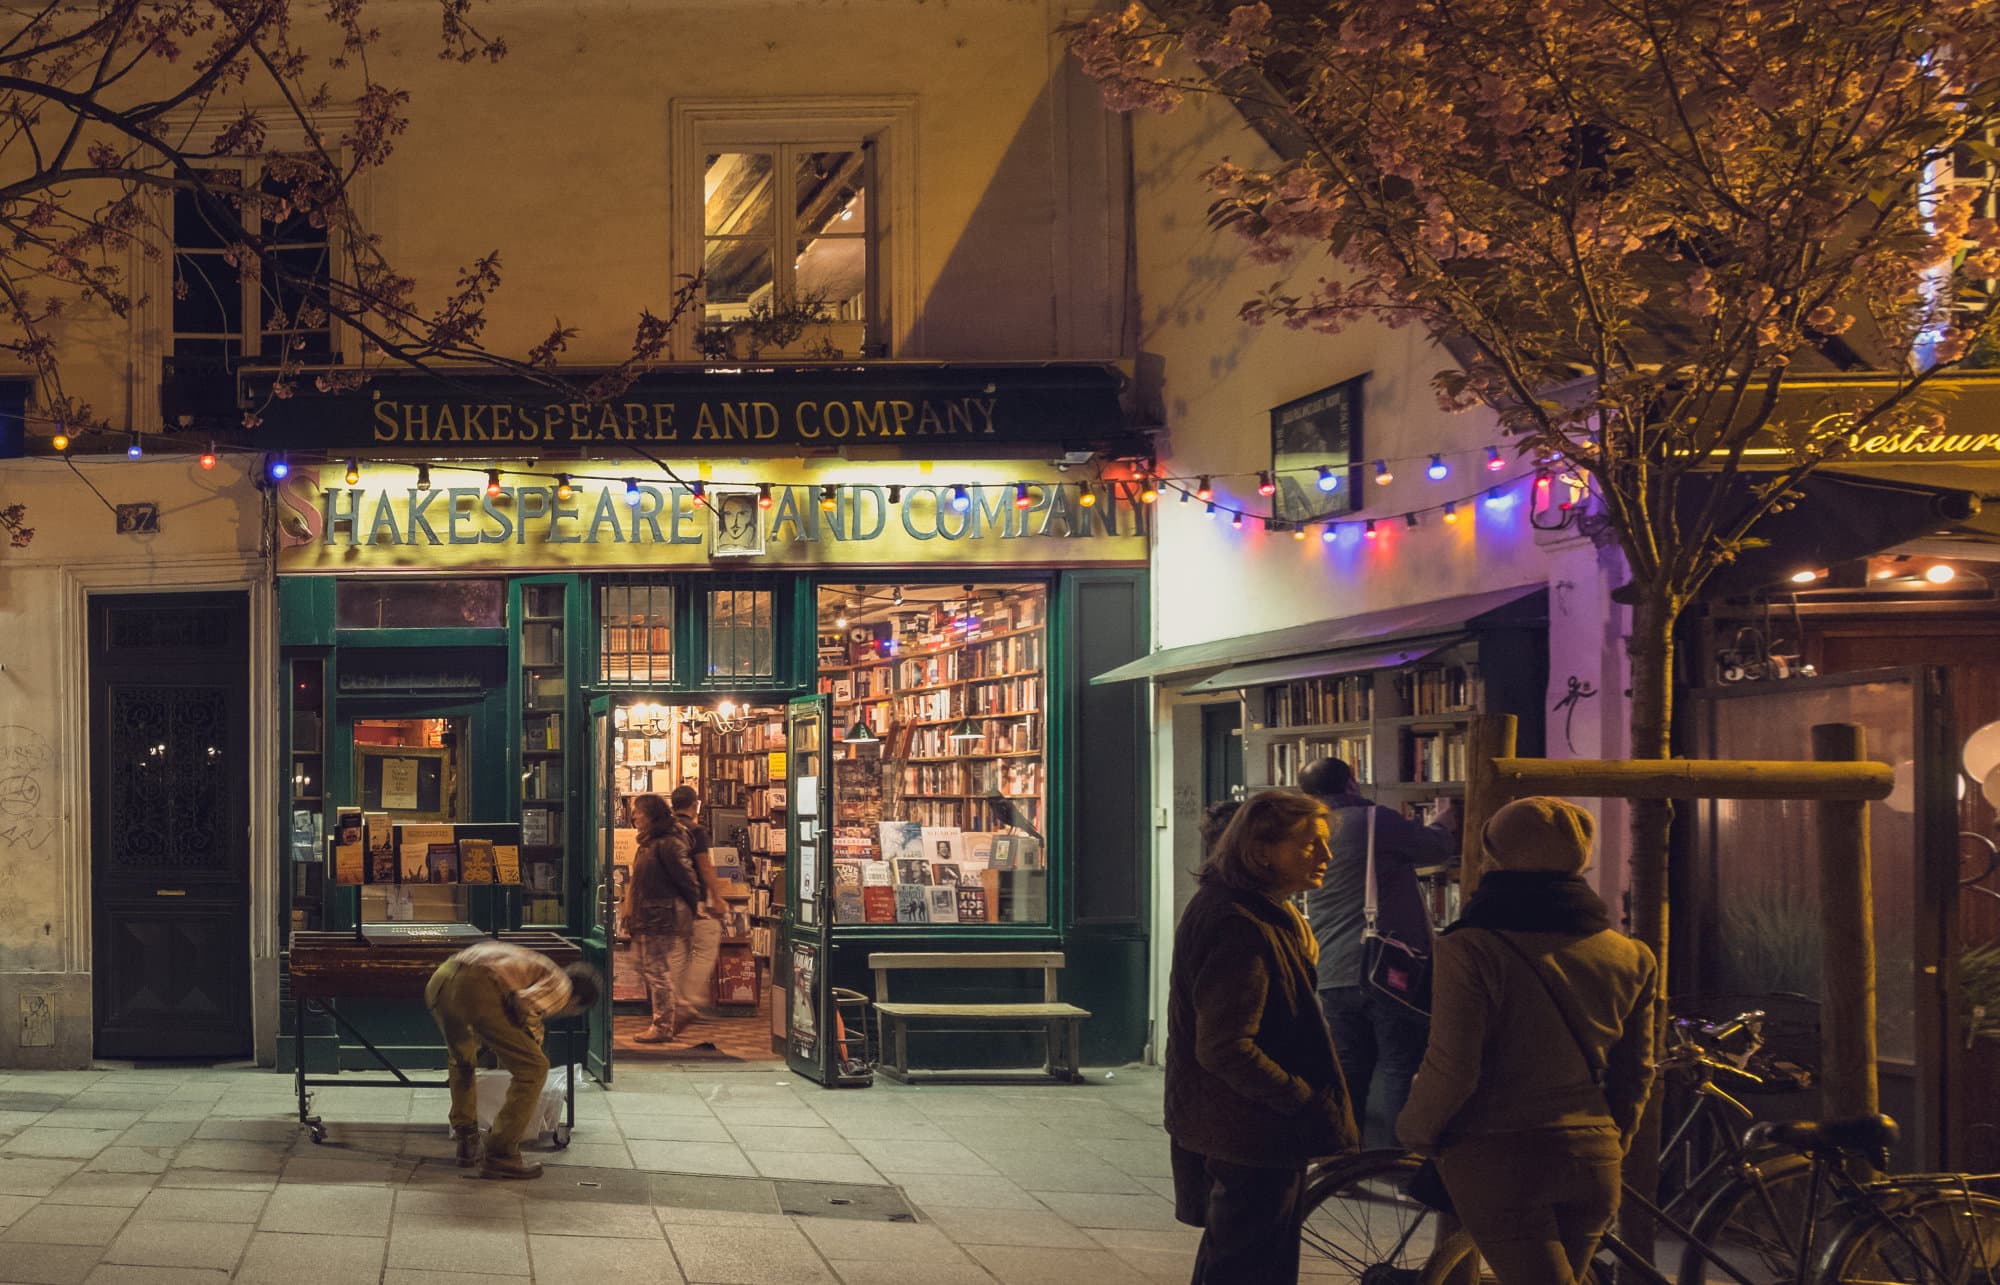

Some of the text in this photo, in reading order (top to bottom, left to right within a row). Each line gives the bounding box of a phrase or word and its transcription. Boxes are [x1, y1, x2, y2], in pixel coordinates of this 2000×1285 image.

[373, 397, 998, 442] SHAKESPEARE AND COMPANY
[122, 507, 154, 532] 37
[278, 468, 1150, 552] SHAKESPEARE AND COMPANY
